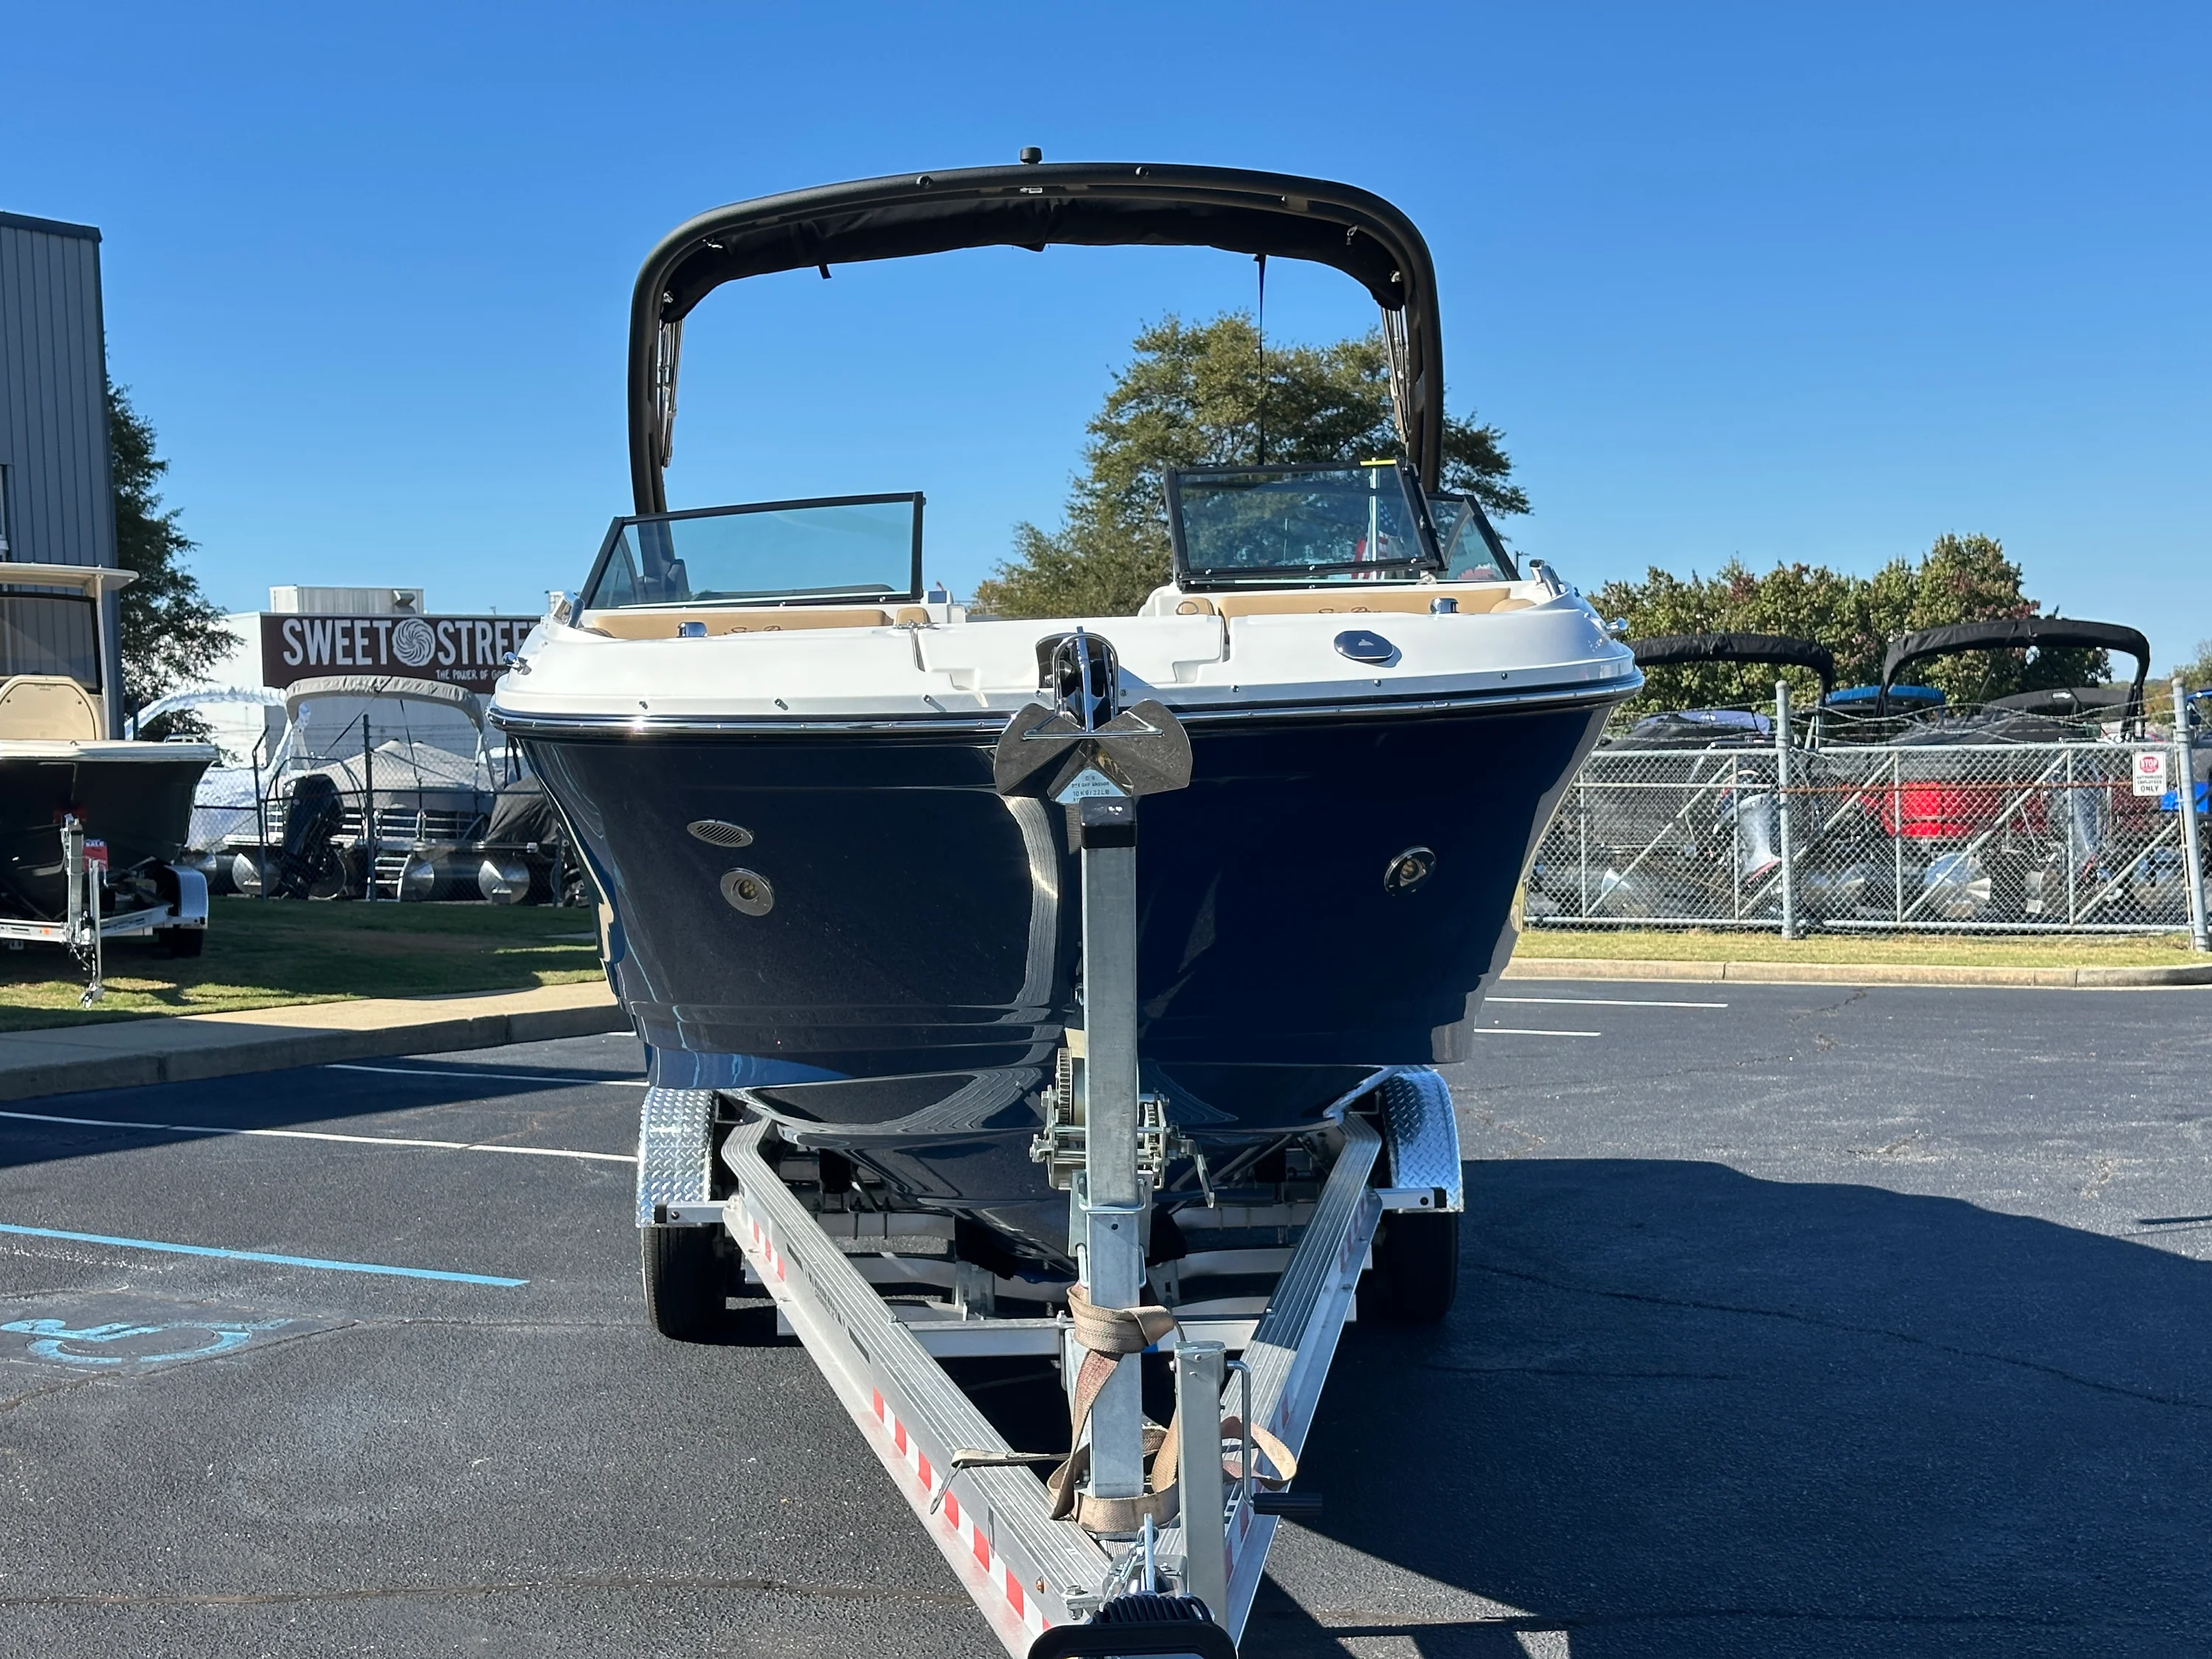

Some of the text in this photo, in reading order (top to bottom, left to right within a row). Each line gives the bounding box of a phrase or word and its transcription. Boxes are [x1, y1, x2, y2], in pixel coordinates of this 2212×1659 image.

[282, 618, 540, 666] SWEET STREE
[435, 669, 450, 681] THE
[452, 669, 478, 681] POWER
[479, 669, 488, 681] OF
[2140, 759, 2158, 768] STOP
